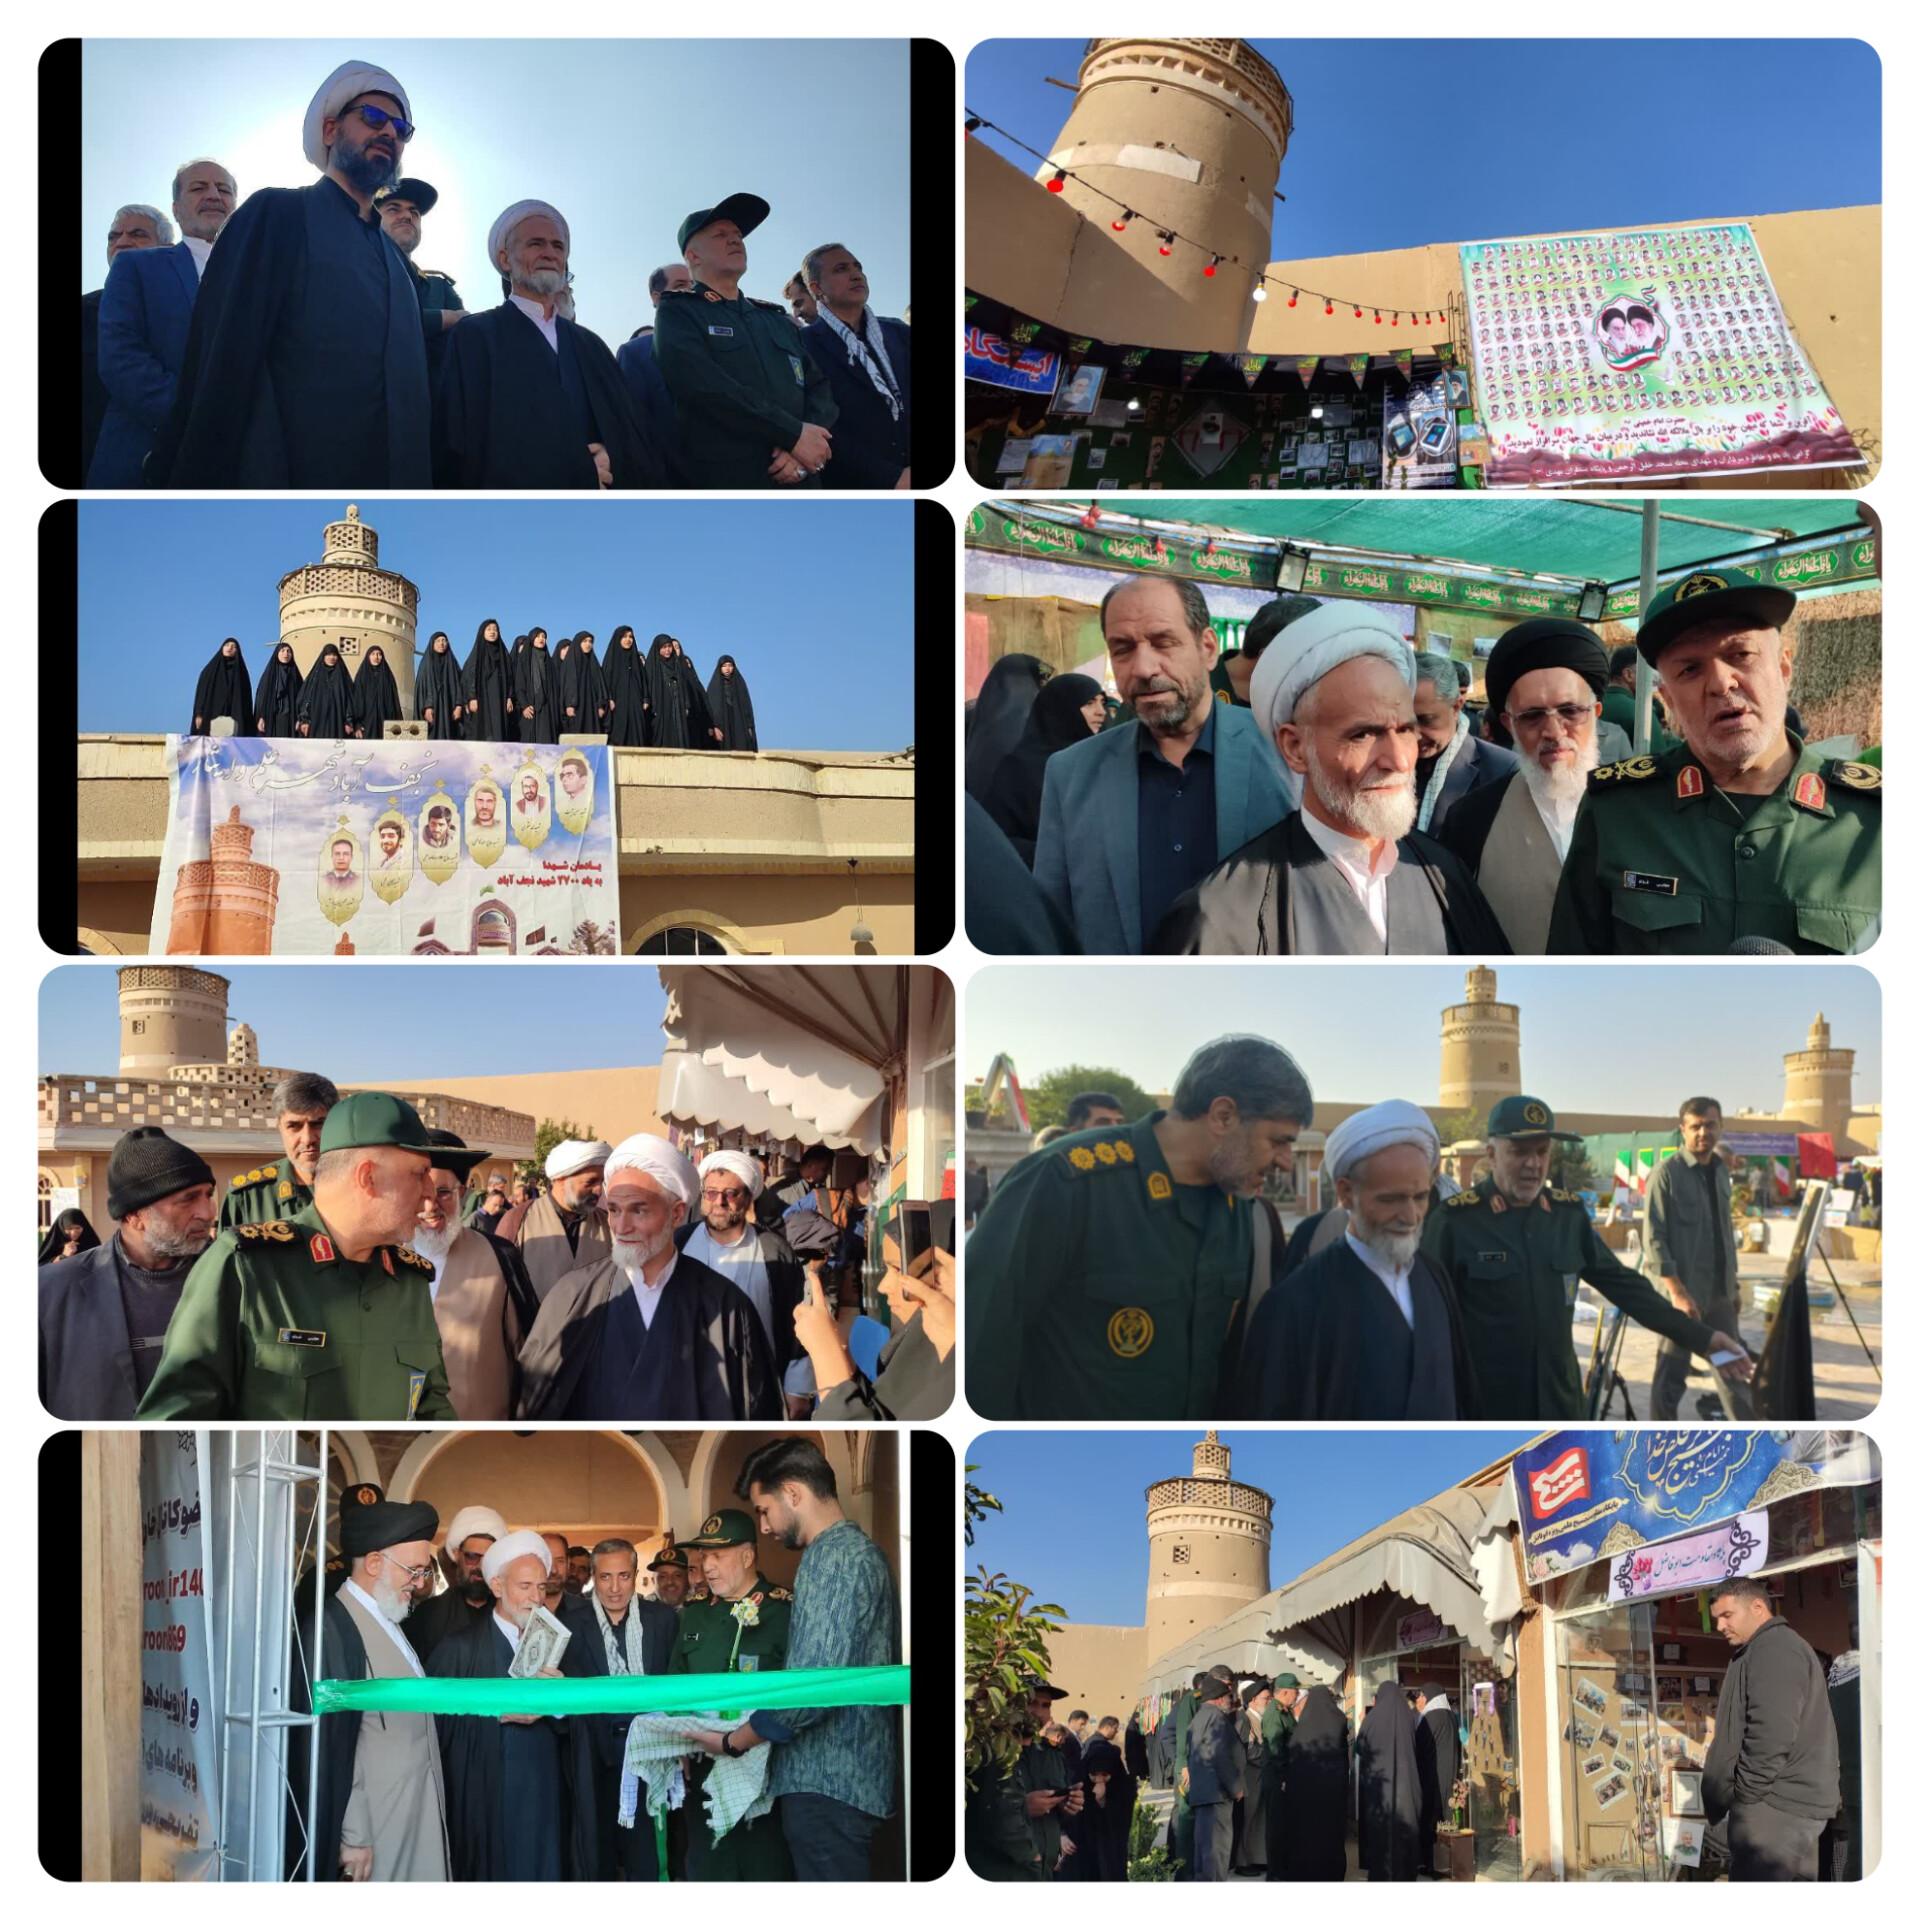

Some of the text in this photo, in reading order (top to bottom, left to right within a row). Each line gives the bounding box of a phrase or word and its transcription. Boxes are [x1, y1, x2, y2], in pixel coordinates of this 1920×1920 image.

[234, 764, 247, 782] و
[249, 749, 279, 789] علم
[256, 738, 347, 796] شهر
[328, 752, 375, 805] آباد
[542, 860, 569, 871] شهدا
[497, 874, 515, 888] آباد
[516, 876, 535, 888] نجف
[536, 876, 556, 887] شهید
[581, 876, 593, 888] یاد
[594, 878, 603, 887] به
[180, 1490, 201, 1536] ضو
[189, 1697, 200, 1729] و
